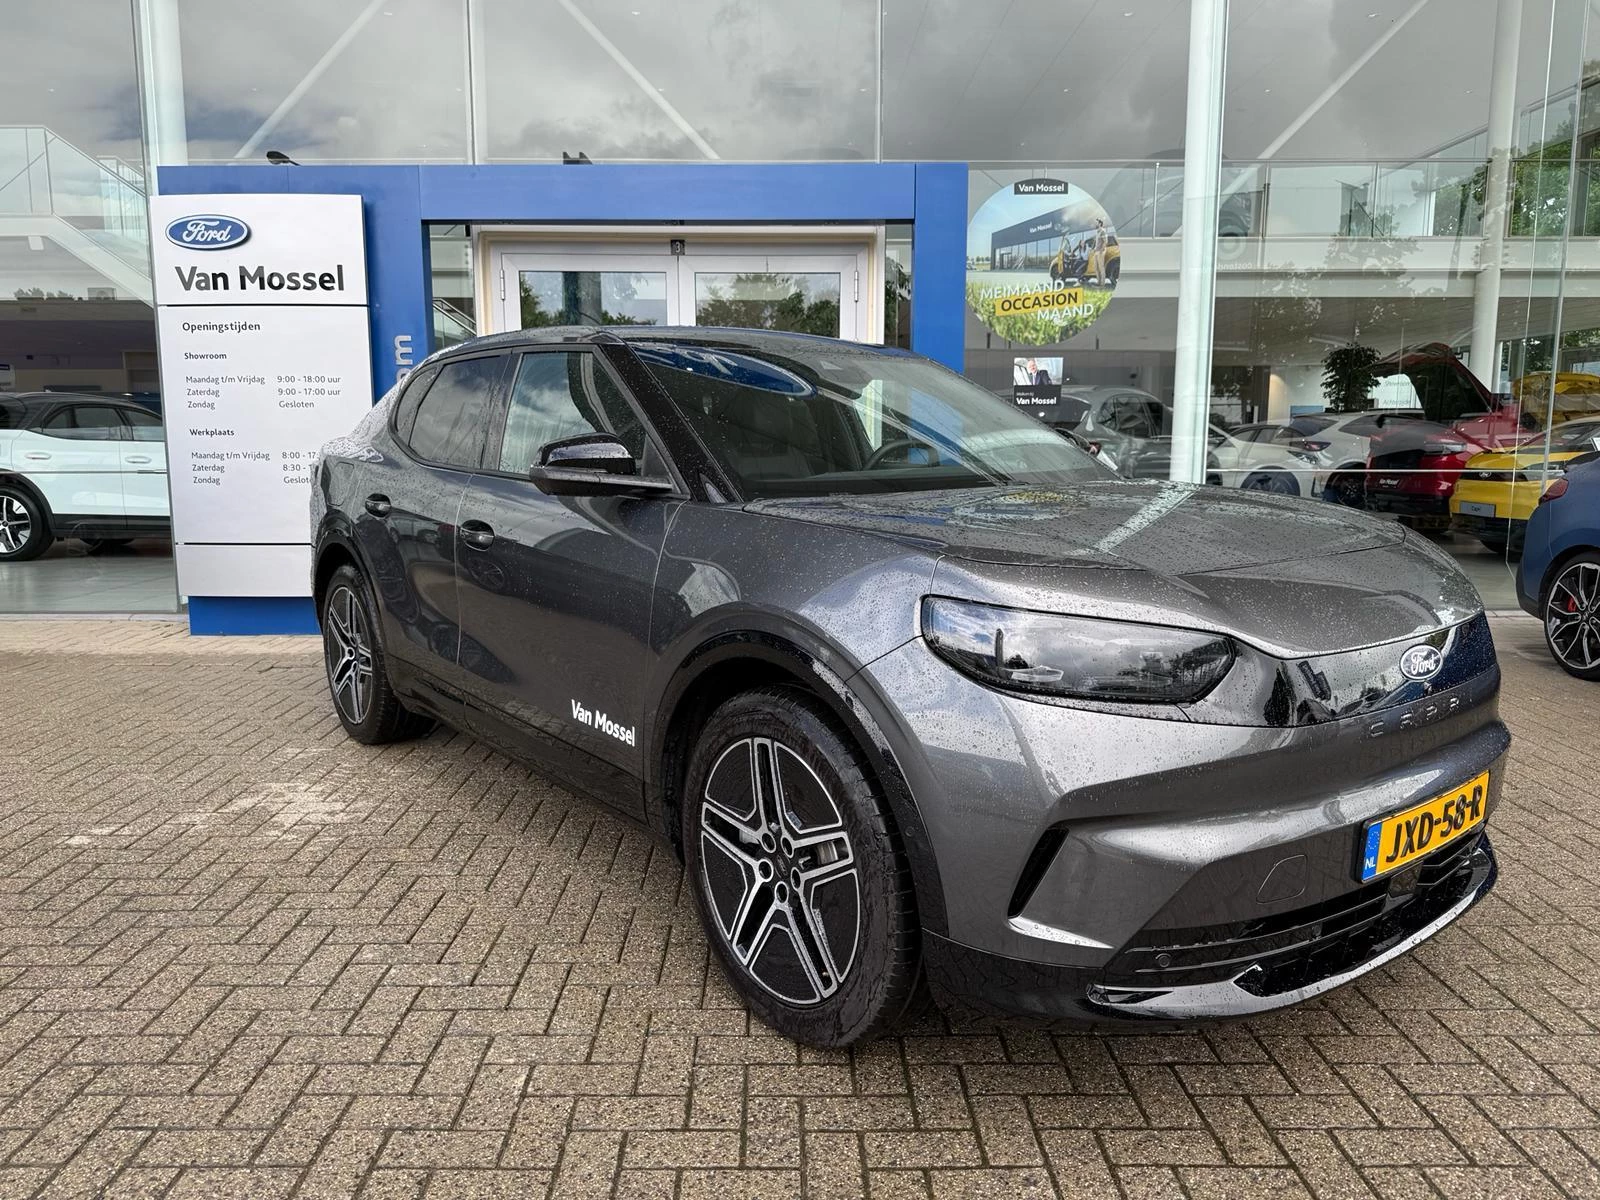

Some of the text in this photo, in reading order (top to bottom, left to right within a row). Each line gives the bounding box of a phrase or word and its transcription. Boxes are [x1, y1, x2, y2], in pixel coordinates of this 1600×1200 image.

[1018, 183, 1065, 192] Van Mossel
[182, 220, 232, 242] Ford
[174, 264, 345, 291] Van Mossel
[980, 279, 1065, 301] MEIMAAND
[1001, 291, 1078, 312] OCCASION
[1037, 303, 1094, 321] MAAND
[182, 321, 261, 333] Openingstijden
[184, 352, 227, 360] Showroom
[185, 375, 220, 385] Maandag
[237, 375, 265, 385] Vrijdag
[277, 375, 296, 384] 9:00
[303, 375, 326, 384] 18:00
[186, 388, 220, 398] Zaterdag
[278, 387, 297, 396] 9:00
[304, 387, 326, 396] 17:00
[327, 388, 341, 396] uur
[187, 400, 216, 411] Zondag
[278, 400, 315, 409] Gesloten
[1016, 396, 1057, 405] Van Mossel
[189, 428, 235, 437] Werkplaats
[191, 451, 271, 461] Maandag t/m Vrijdag
[281, 451, 300, 459] 8:00
[192, 464, 225, 473] Zaterdag
[282, 464, 301, 472] 8:30
[193, 476, 221, 486] Zondag
[283, 476, 313, 484] Geslot
[1410, 652, 1436, 675] Ford
[571, 699, 635, 747] Van Mossel
[1385, 784, 1483, 863] JXD-58-R
[1364, 856, 1376, 869] NL
